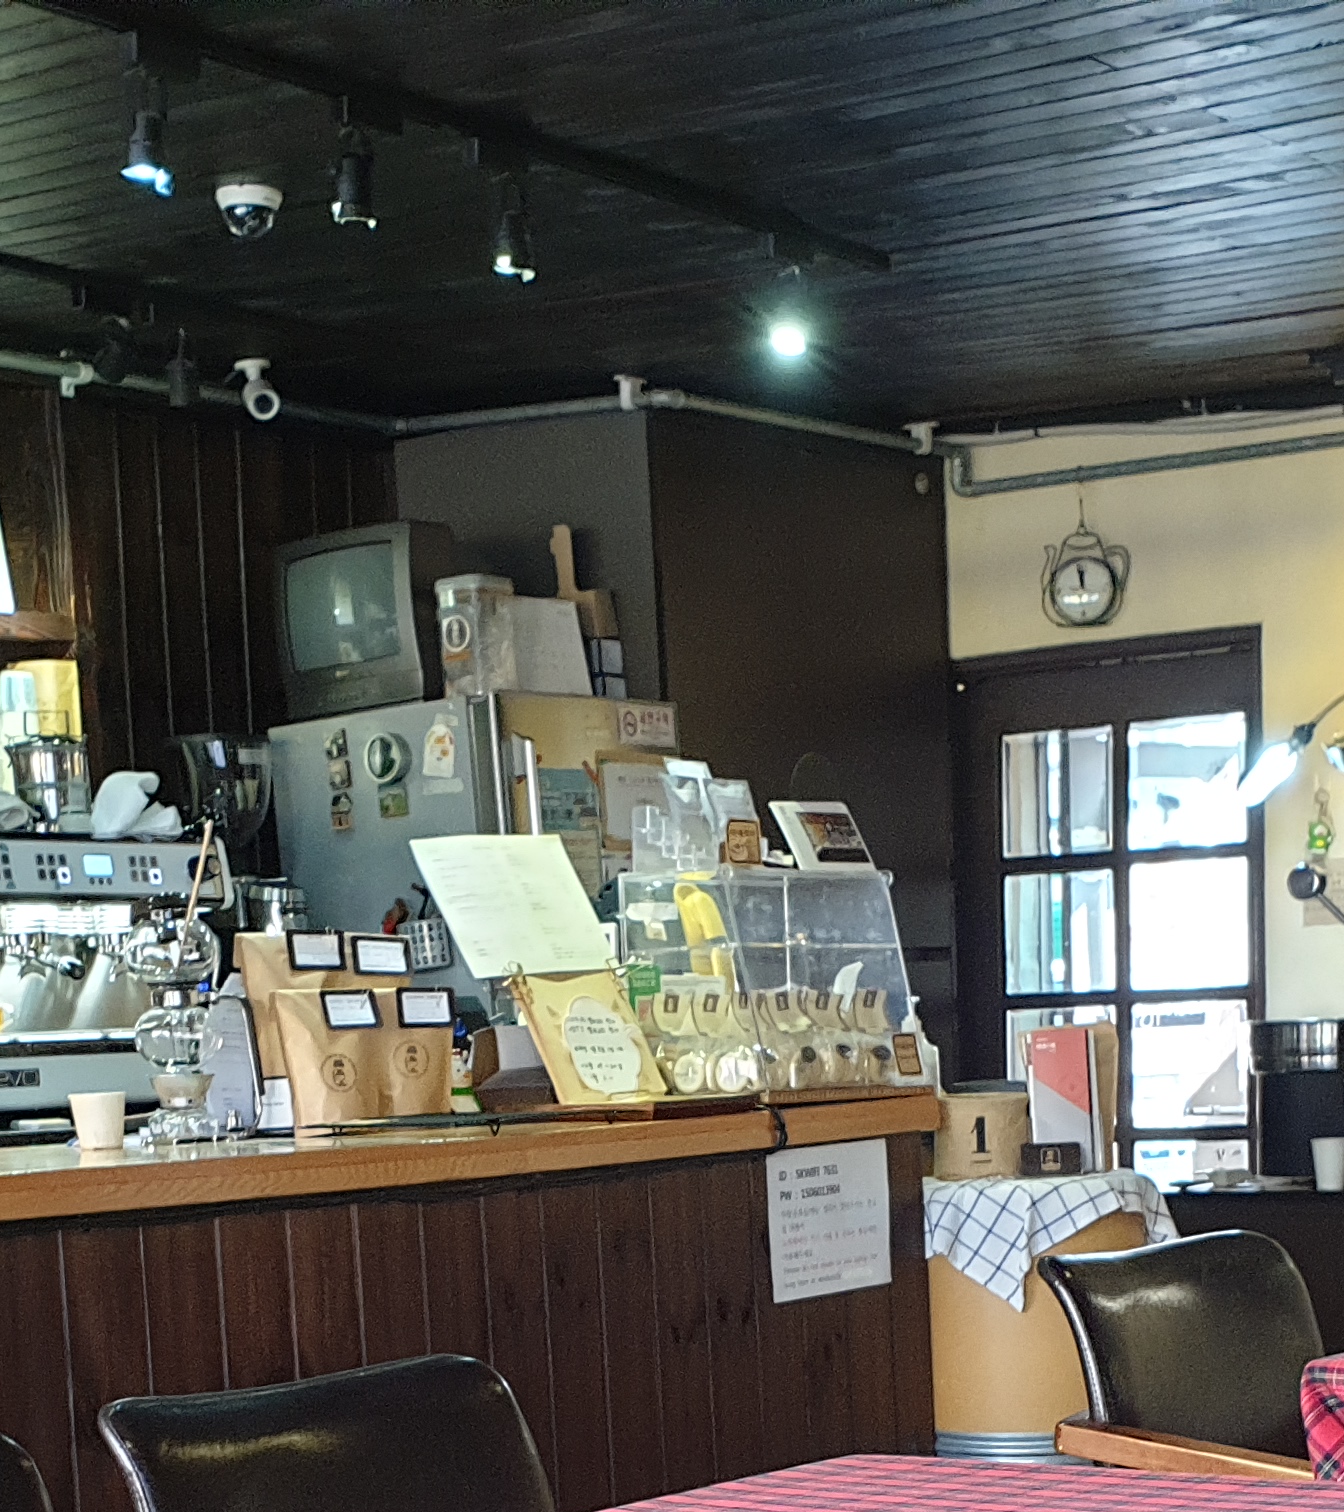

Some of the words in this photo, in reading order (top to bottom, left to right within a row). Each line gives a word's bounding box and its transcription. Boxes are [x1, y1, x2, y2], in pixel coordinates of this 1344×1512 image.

[970, 1115, 991, 1154] 1
[778, 1170, 787, 1181] ID
[779, 1191, 792, 1201] PW
